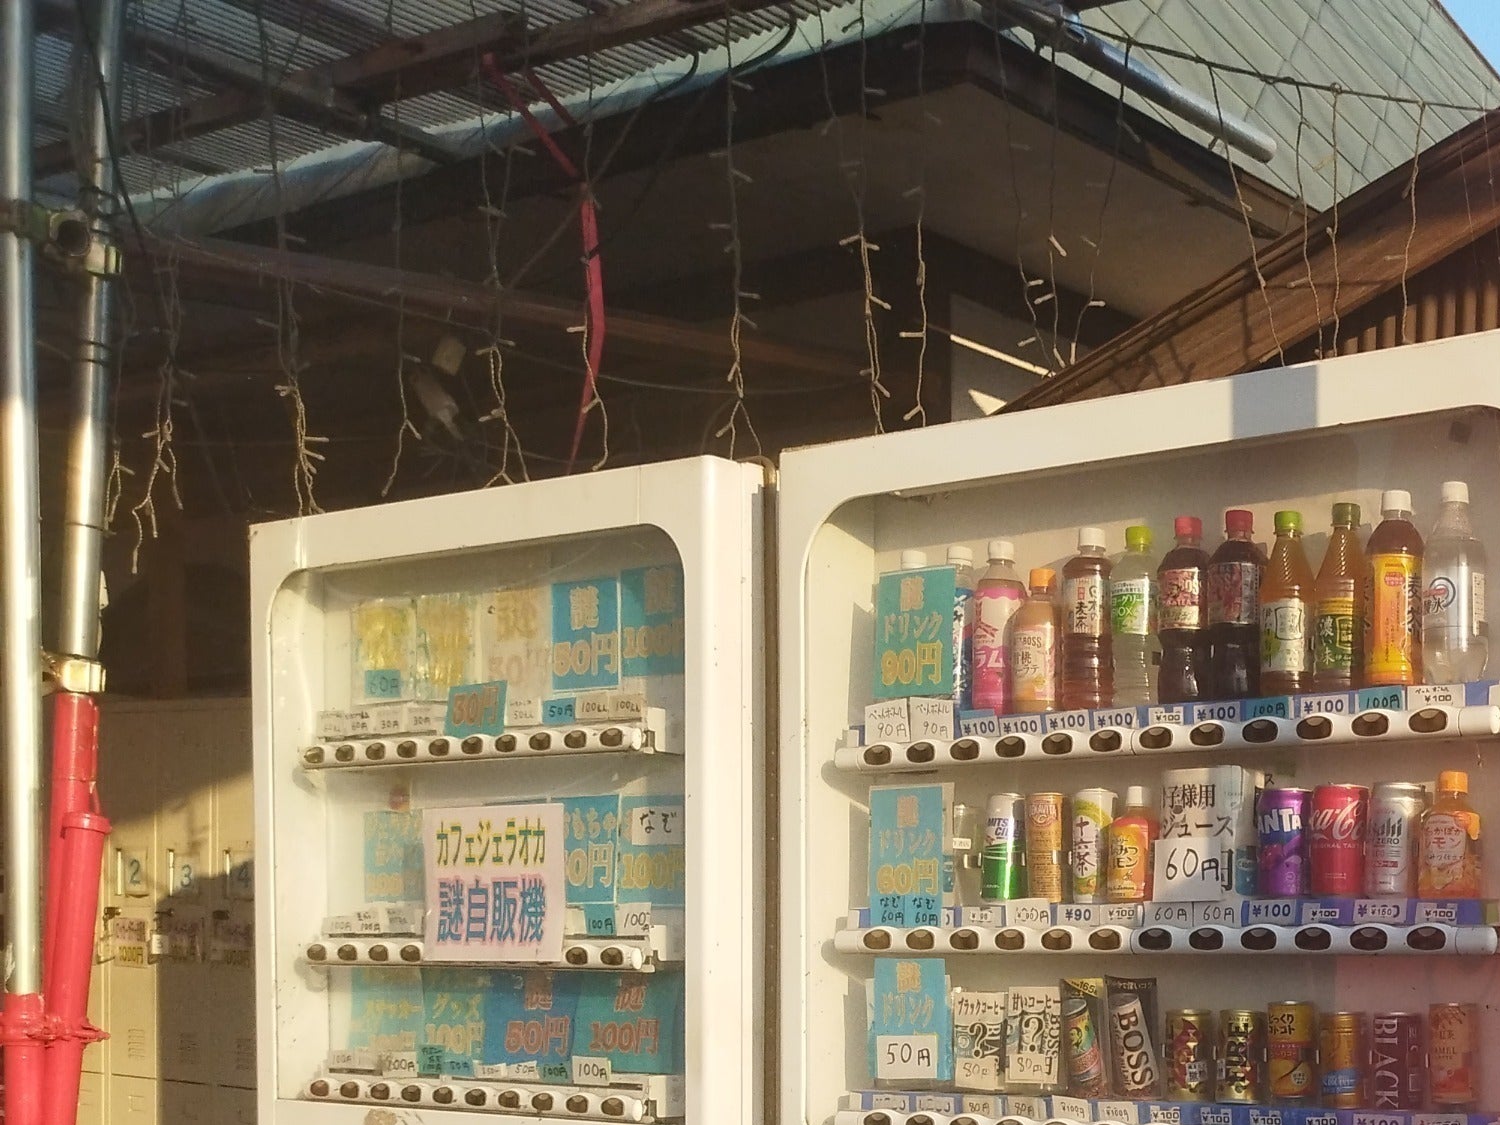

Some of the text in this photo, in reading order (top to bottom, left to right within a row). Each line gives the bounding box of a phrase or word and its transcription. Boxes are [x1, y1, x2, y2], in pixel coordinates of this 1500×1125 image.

[884, 611, 943, 644] ドリンク
[553, 632, 619, 676] 50円
[881, 639, 943, 686] 90円
[1253, 702, 1287, 718] 100円
[1304, 699, 1344, 713] ¥100
[1366, 694, 1400, 709] 100円
[1049, 714, 1086, 730] ¥100
[1097, 712, 1133, 728] ¥100
[1197, 706, 1236, 720] ¥100
[877, 721, 908, 738] 90円
[923, 721, 949, 736] 90円
[964, 720, 996, 735] ¥100
[1003, 720, 1038, 734] ¥100
[1162, 784, 1216, 810] 子様用
[639, 810, 677, 834] なぞ
[1163, 812, 1234, 840] ジュース
[1258, 807, 1303, 834] ANTA
[436, 817, 547, 867] カフェジェラオカ
[1075, 817, 1096, 877] 十六茶
[129, 859, 142, 886] 2
[565, 840, 615, 889] 0円
[1166, 848, 1219, 881] 60円
[180, 864, 192, 887] 3
[877, 857, 939, 896] 60円
[436, 877, 547, 945] 謎自販機
[881, 911, 904, 925] 60円
[915, 911, 938, 926] 60円
[1065, 908, 1092, 922] ¥90
[1155, 907, 1187, 921] 60円
[1203, 905, 1235, 923] 60円
[1252, 904, 1292, 918] ¥100
[1311, 909, 1337, 918] ¥100
[1425, 910, 1453, 918] ¥100
[588, 918, 614, 933] 100円
[1012, 993, 1061, 1011] 甘いコーヒー
[505, 1015, 570, 1056] 50円
[589, 1016, 660, 1055] 100円
[887, 1043, 931, 1067] 50円
[1117, 1008, 1154, 1087] BOSS
[578, 1063, 607, 1081] 100円
[1374, 1017, 1399, 1109] BLACK
[1152, 1111, 1179, 1120] ¥100
[1202, 1114, 1230, 1123] ¥100
[1253, 1117, 1281, 1125] ¥100
